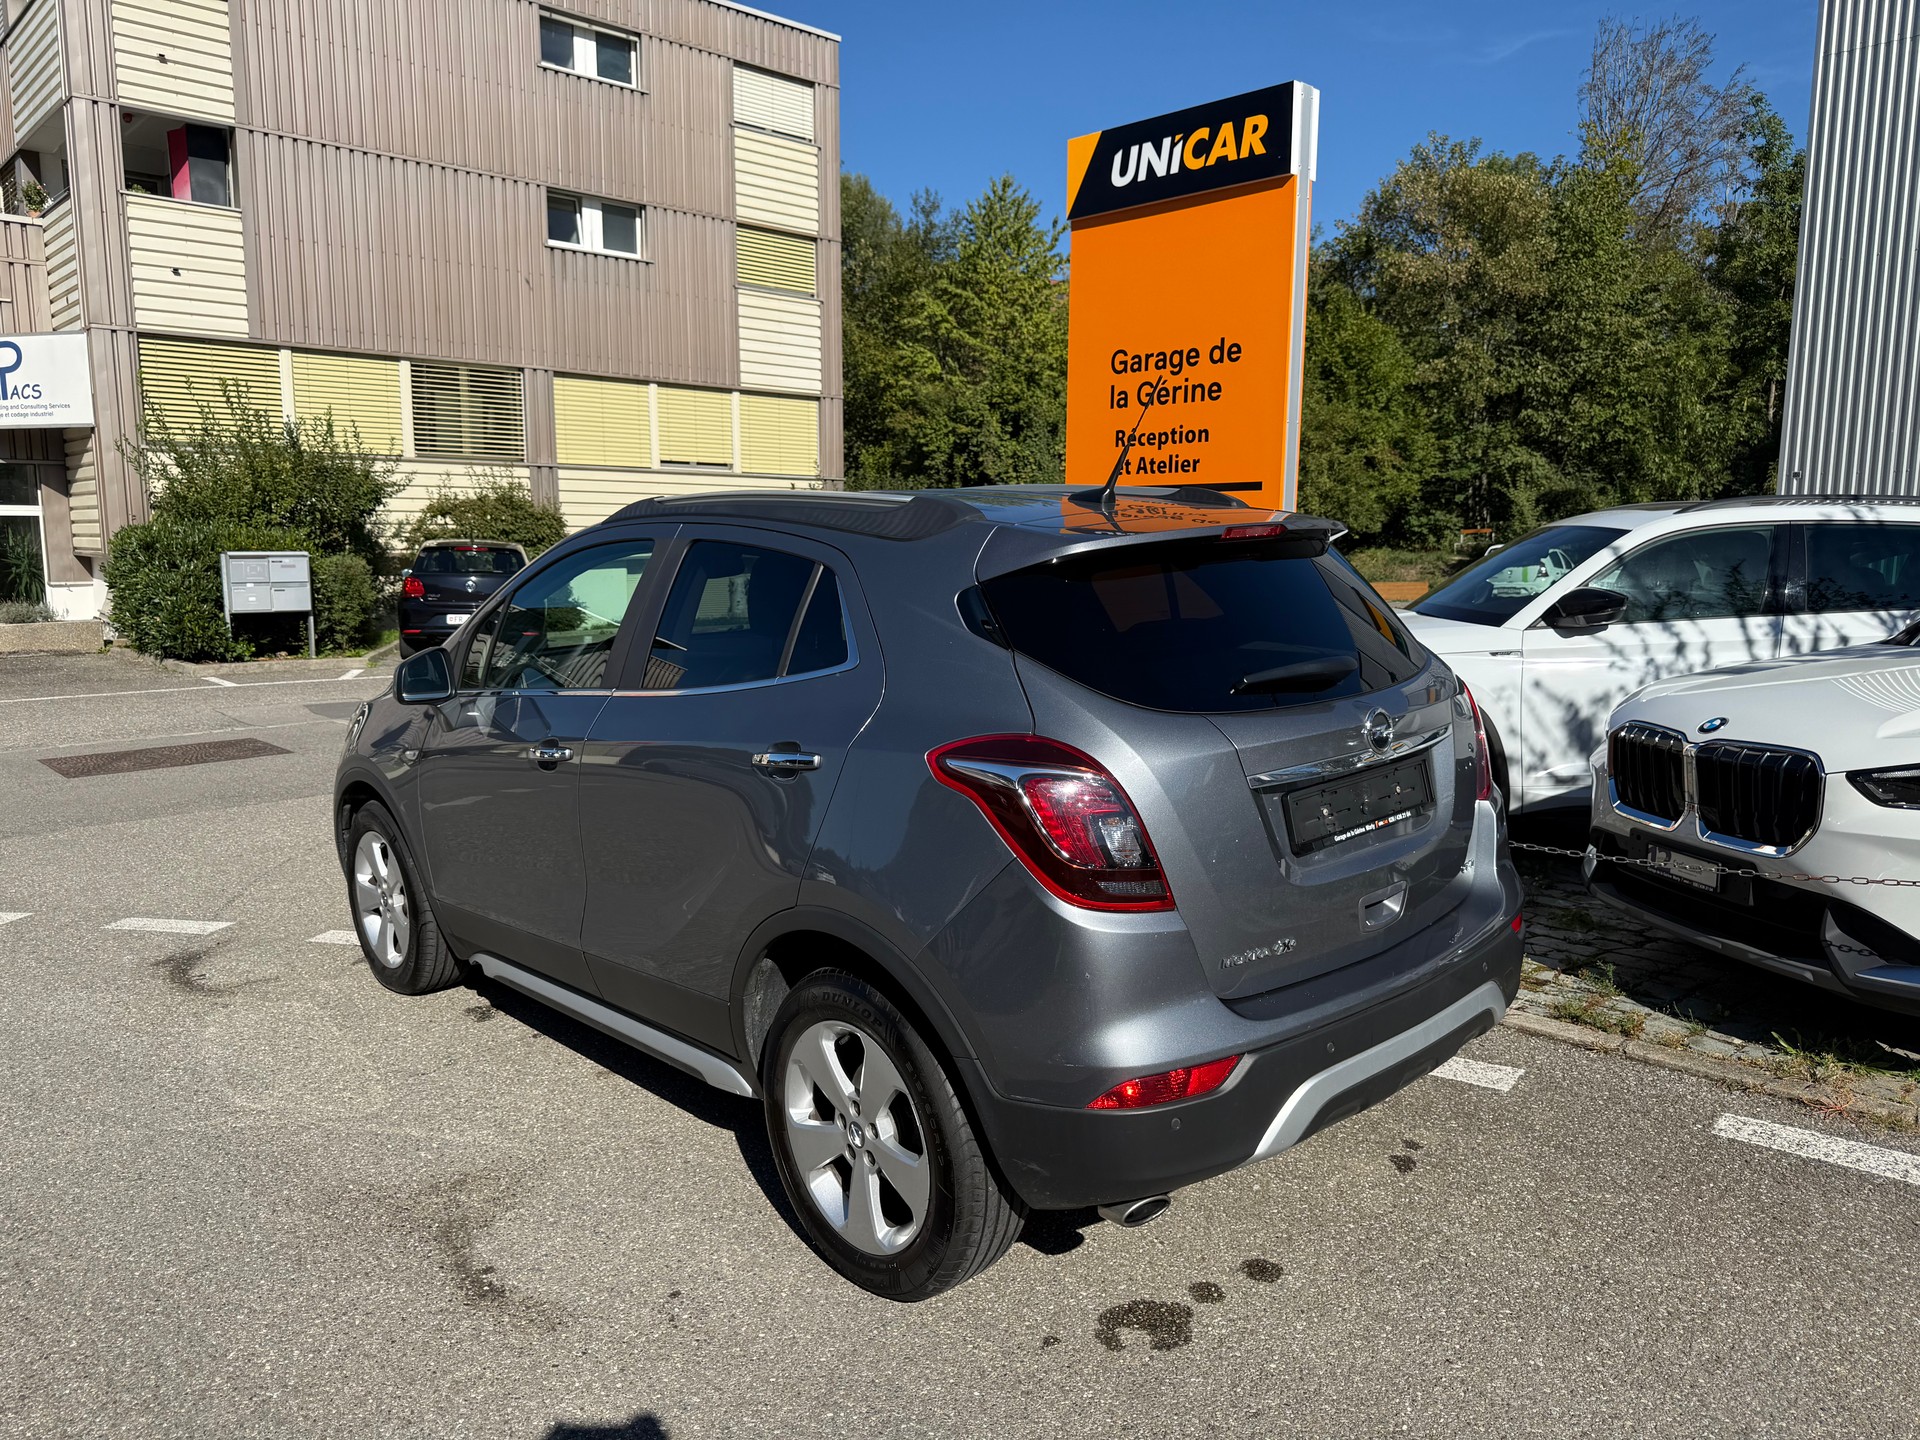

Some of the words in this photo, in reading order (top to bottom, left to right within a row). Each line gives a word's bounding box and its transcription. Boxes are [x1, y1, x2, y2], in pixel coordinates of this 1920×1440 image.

[1110, 347, 1200, 376] Garage
[1208, 337, 1242, 365] de
[20, 403, 48, 411] Consulting
[1110, 384, 1129, 410] la
[1137, 377, 1222, 407] Gérine
[1136, 453, 1200, 475] Atelier
[822, 991, 883, 1028] DUNLOP
